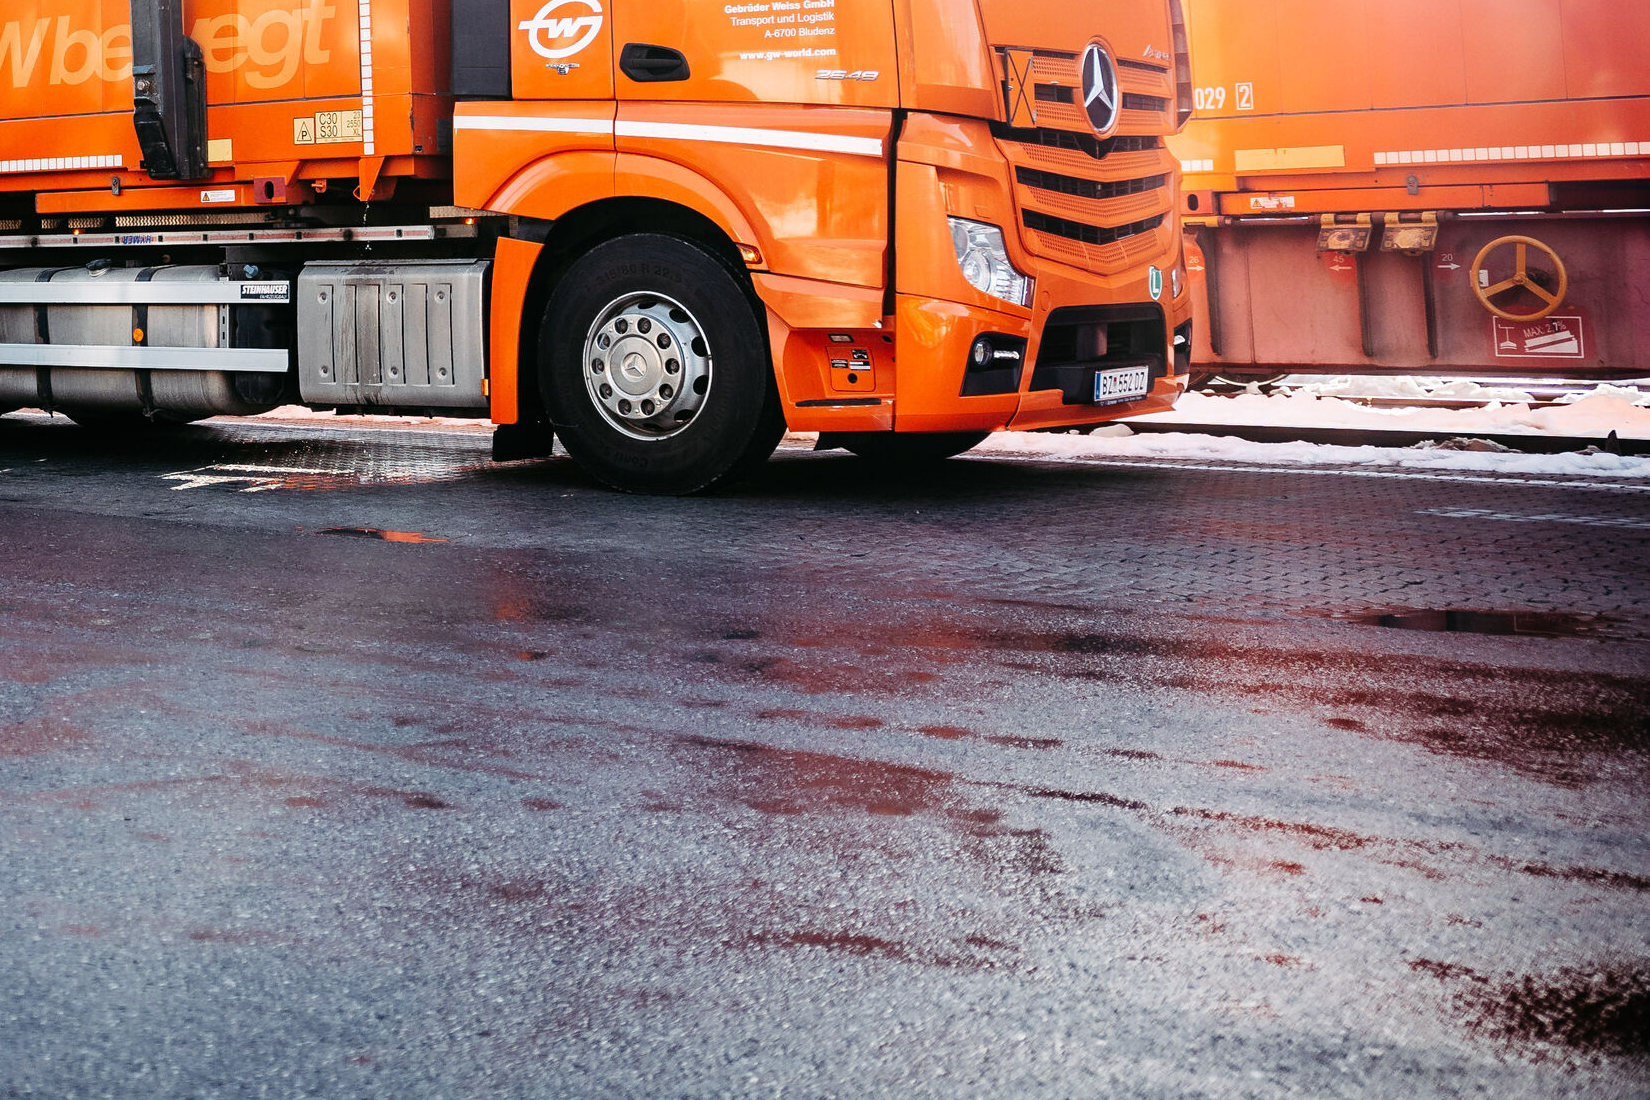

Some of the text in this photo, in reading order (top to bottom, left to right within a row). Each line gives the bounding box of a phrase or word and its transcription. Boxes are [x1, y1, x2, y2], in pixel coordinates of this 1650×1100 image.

[724, 1, 770, 14] Gebrüder
[771, 1, 800, 11] Weiss
[730, 11, 835, 27] Transport und Logistik
[764, 26, 836, 39] A-6700 Bludenz
[739, 47, 837, 61] www.gw-world.com
[1195, 85, 1251, 110] 029 2
[319, 112, 338, 126] C30
[347, 120, 361, 129] 2550
[301, 130, 308, 140] P
[319, 124, 338, 138] S30
[121, 235, 152, 245] HYMER
[1332, 255, 1345, 264] 45
[1440, 253, 1454, 263] 20
[1152, 271, 1160, 294] L
[241, 284, 289, 295] STEINHAUSER
[1102, 371, 1145, 395] BZ 552 DZ
